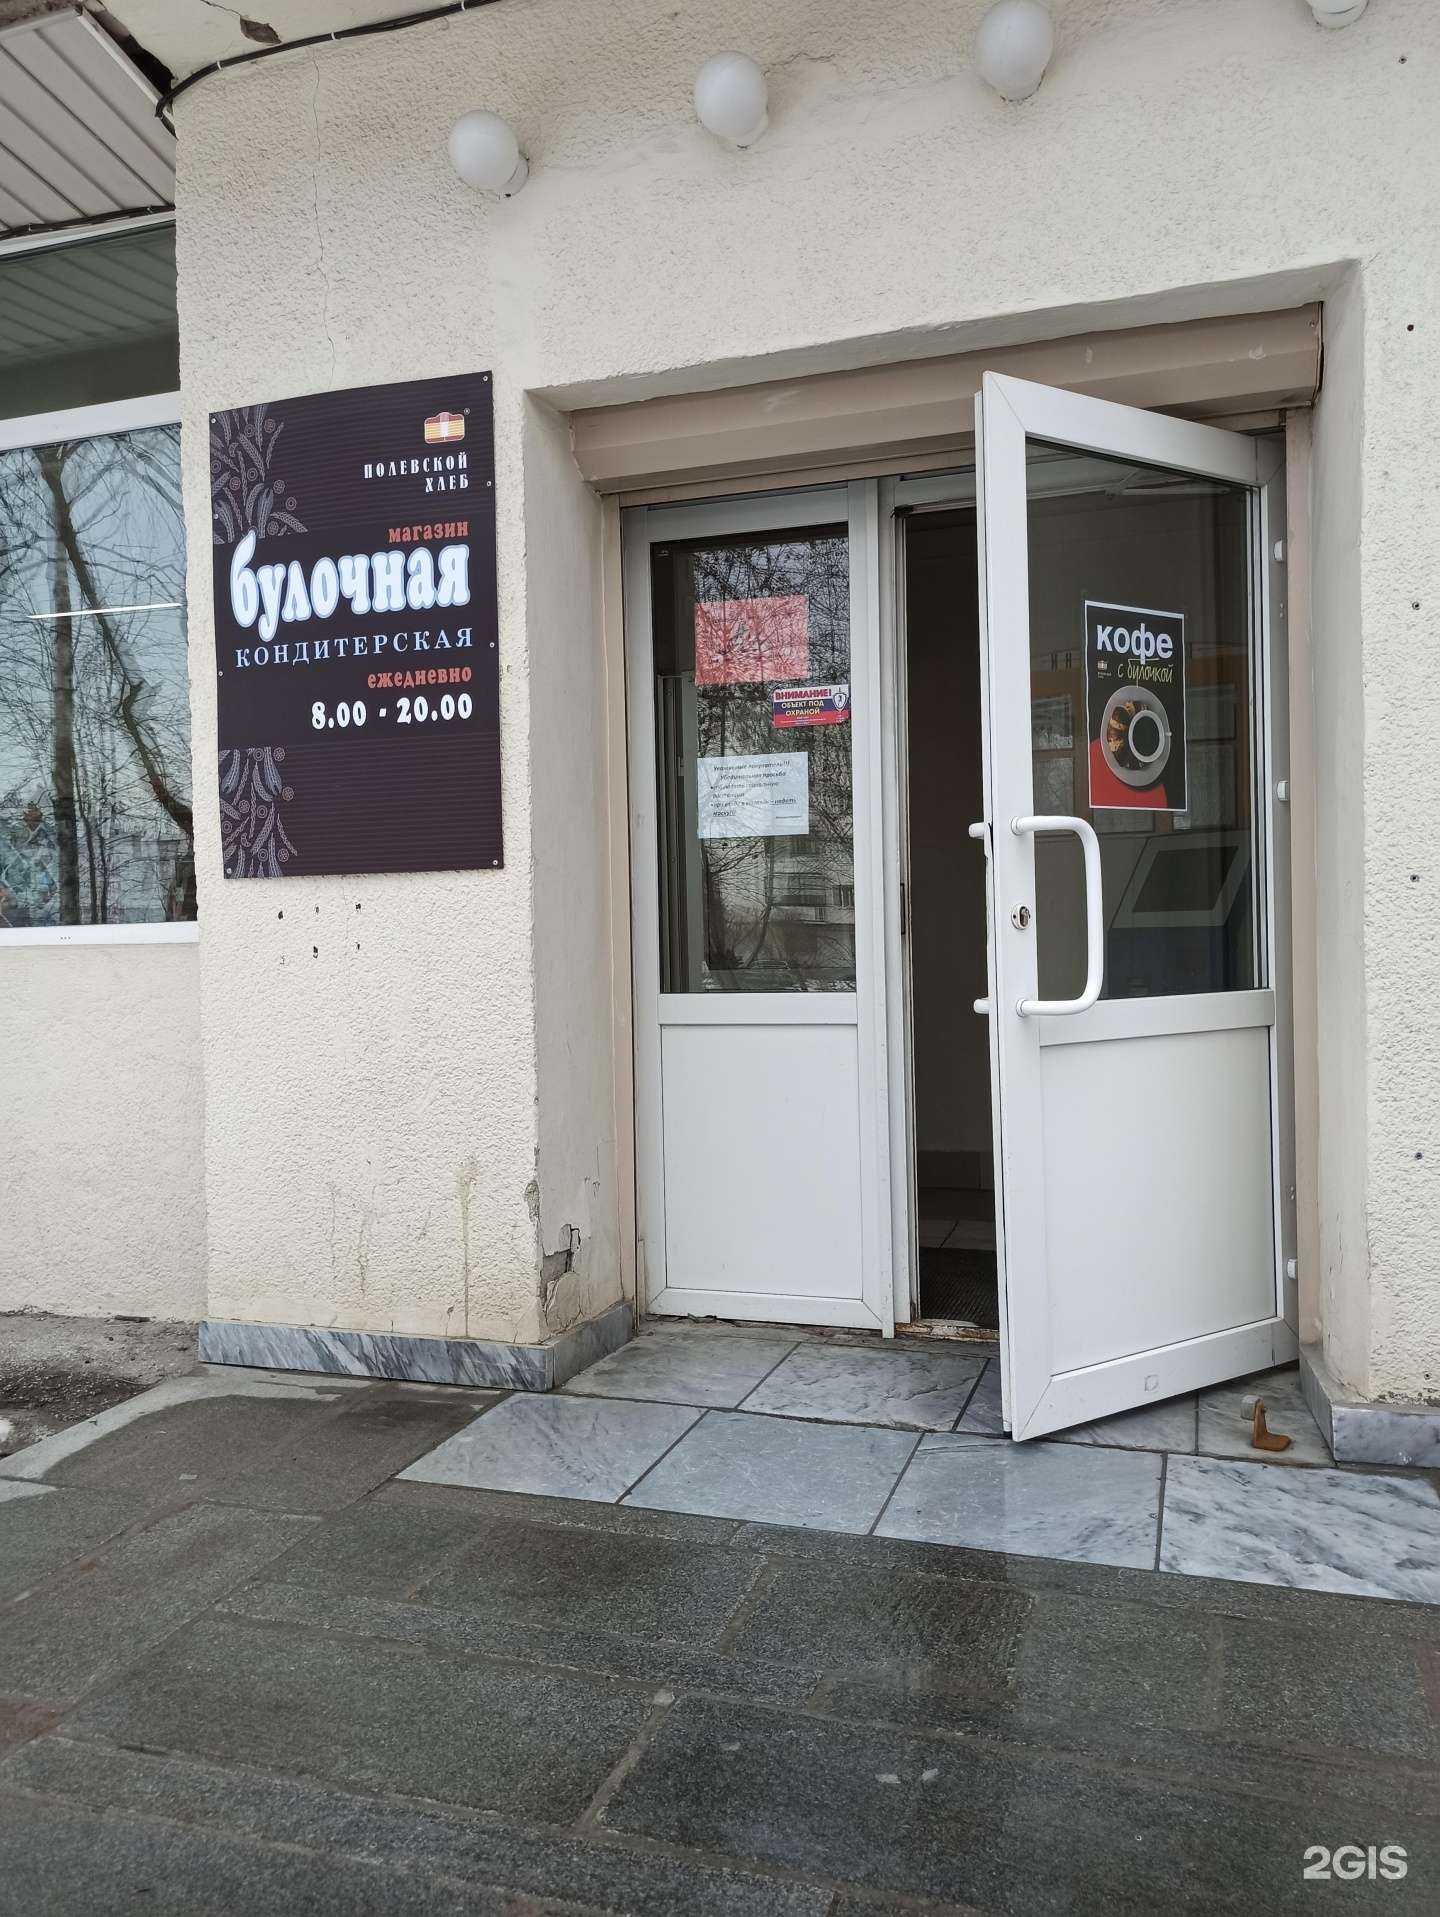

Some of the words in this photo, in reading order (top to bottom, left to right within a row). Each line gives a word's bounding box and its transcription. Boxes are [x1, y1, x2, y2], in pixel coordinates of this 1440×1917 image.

[364, 451, 468, 479] ПОЛЕВСКОЙ
[425, 476, 470, 493] ХЛЕБ
[388, 521, 469, 543] магазин
[230, 529, 471, 642] булочная
[235, 627, 473, 668] КОНДИТЕРСКАЯ
[1097, 623, 1173, 664] кофе
[367, 665, 472, 689] ежедневно
[775, 688, 831, 701] ВНИМАНИЕ!
[781, 701, 807, 709] ОБЪЕКТ
[808, 699, 824, 707] ПОД
[311, 700, 367, 730] 8.00
[396, 693, 473, 725] 20.00
[785, 707, 820, 716] ОХРАНОЙ
